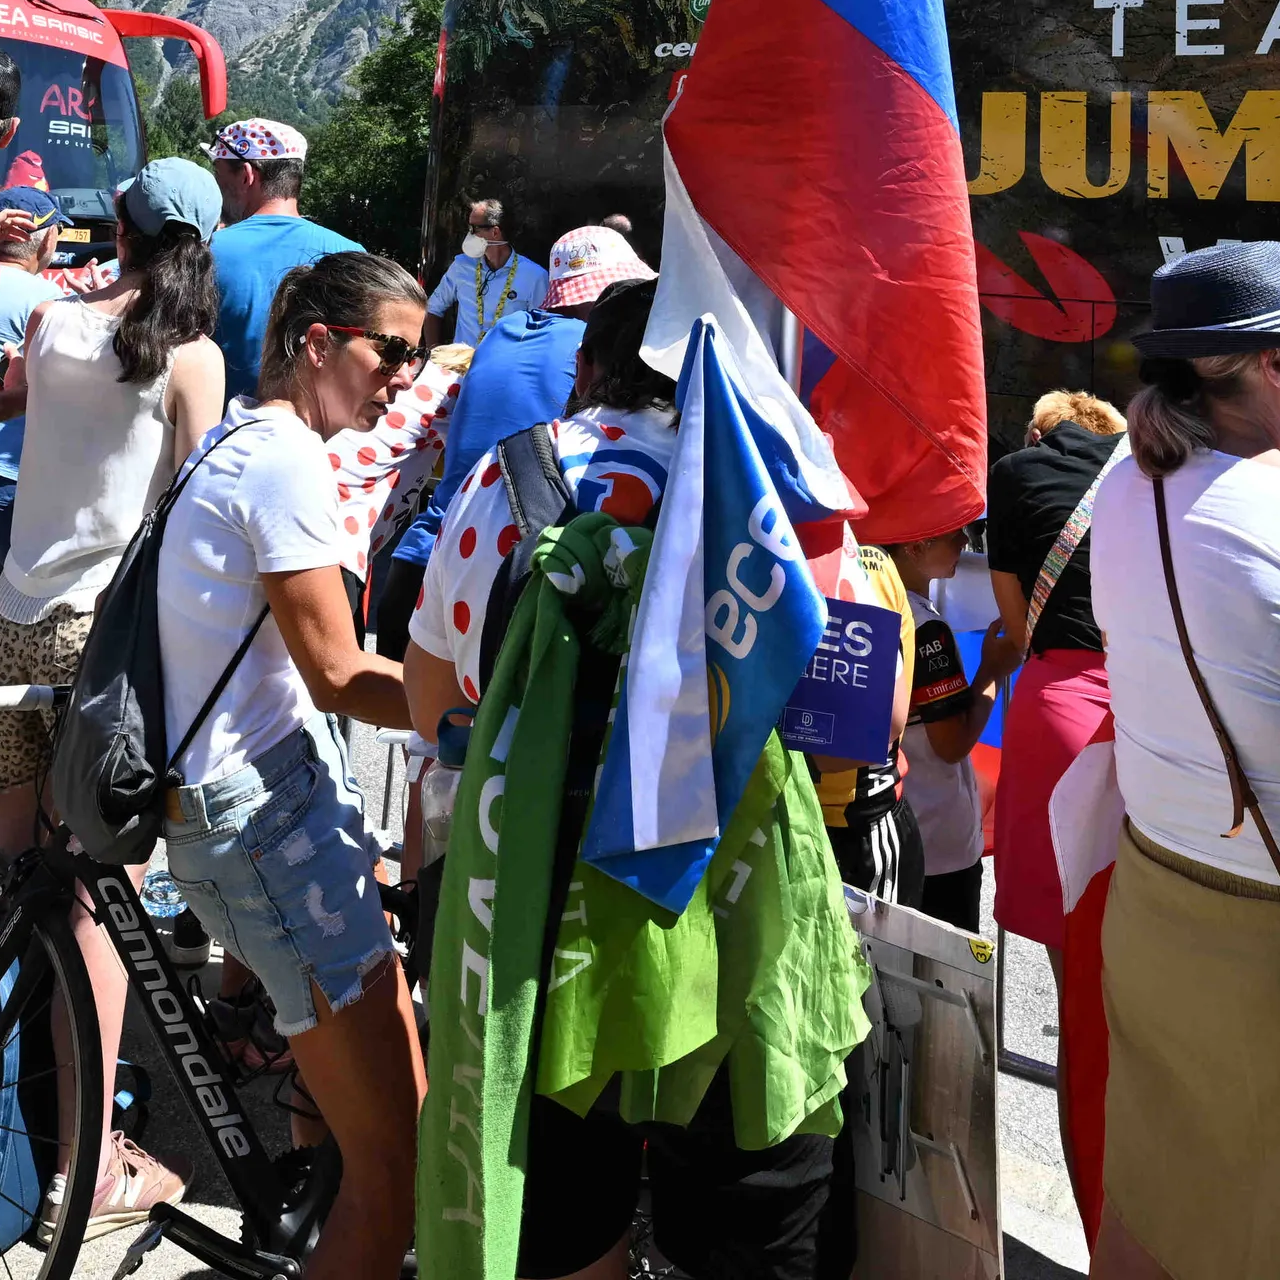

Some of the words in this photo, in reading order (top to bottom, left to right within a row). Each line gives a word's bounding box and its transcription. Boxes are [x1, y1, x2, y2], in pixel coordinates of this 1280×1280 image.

[32, 15, 104, 45] SAMSIC
[48, 120, 91, 138] SA
[919, 639, 943, 658] FAB
[800, 655, 870, 689] ERE
[926, 677, 964, 698] Emirates
[97, 876, 252, 1159] cannondale
